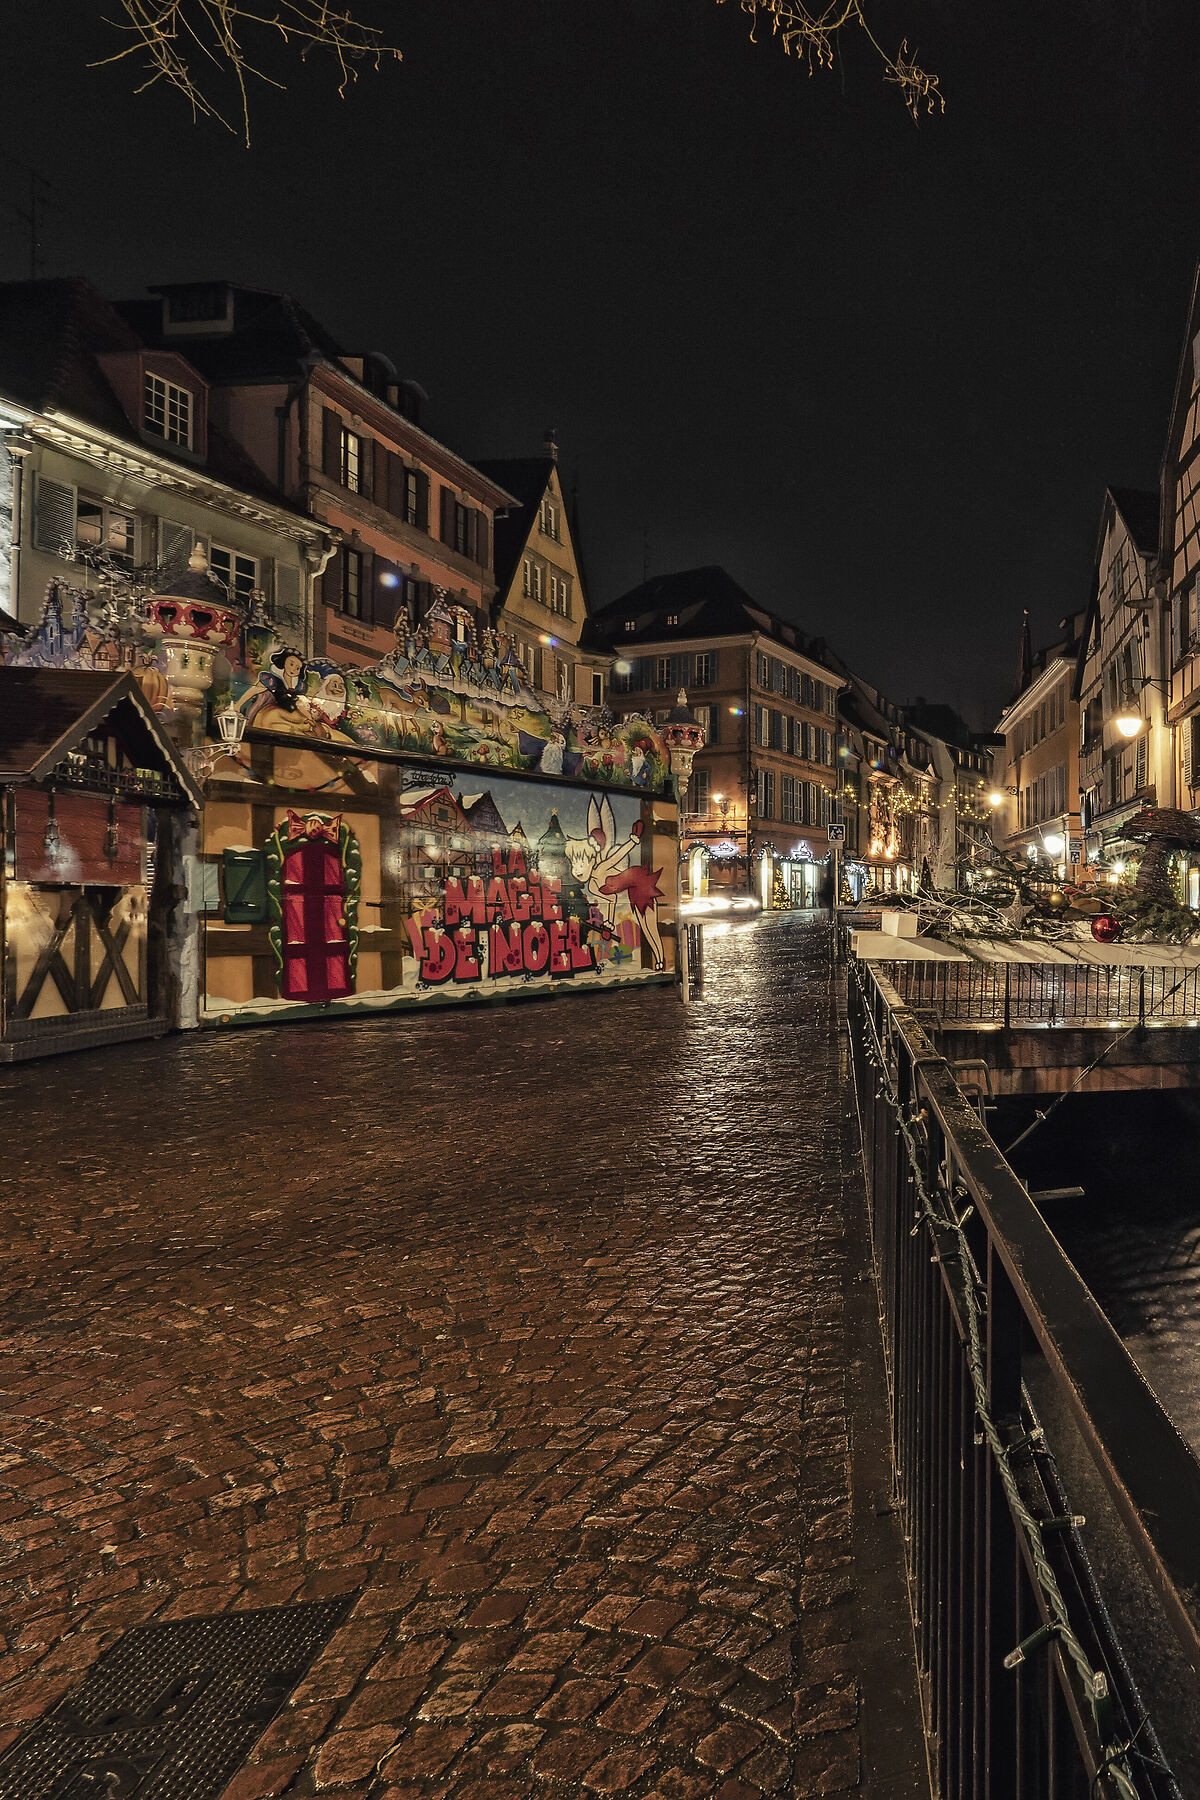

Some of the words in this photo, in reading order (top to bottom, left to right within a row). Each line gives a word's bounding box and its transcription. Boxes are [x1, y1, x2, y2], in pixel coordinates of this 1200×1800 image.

[492, 844, 527, 875] LA
[420, 926, 481, 984] DE
[489, 917, 593, 976] NOEL
